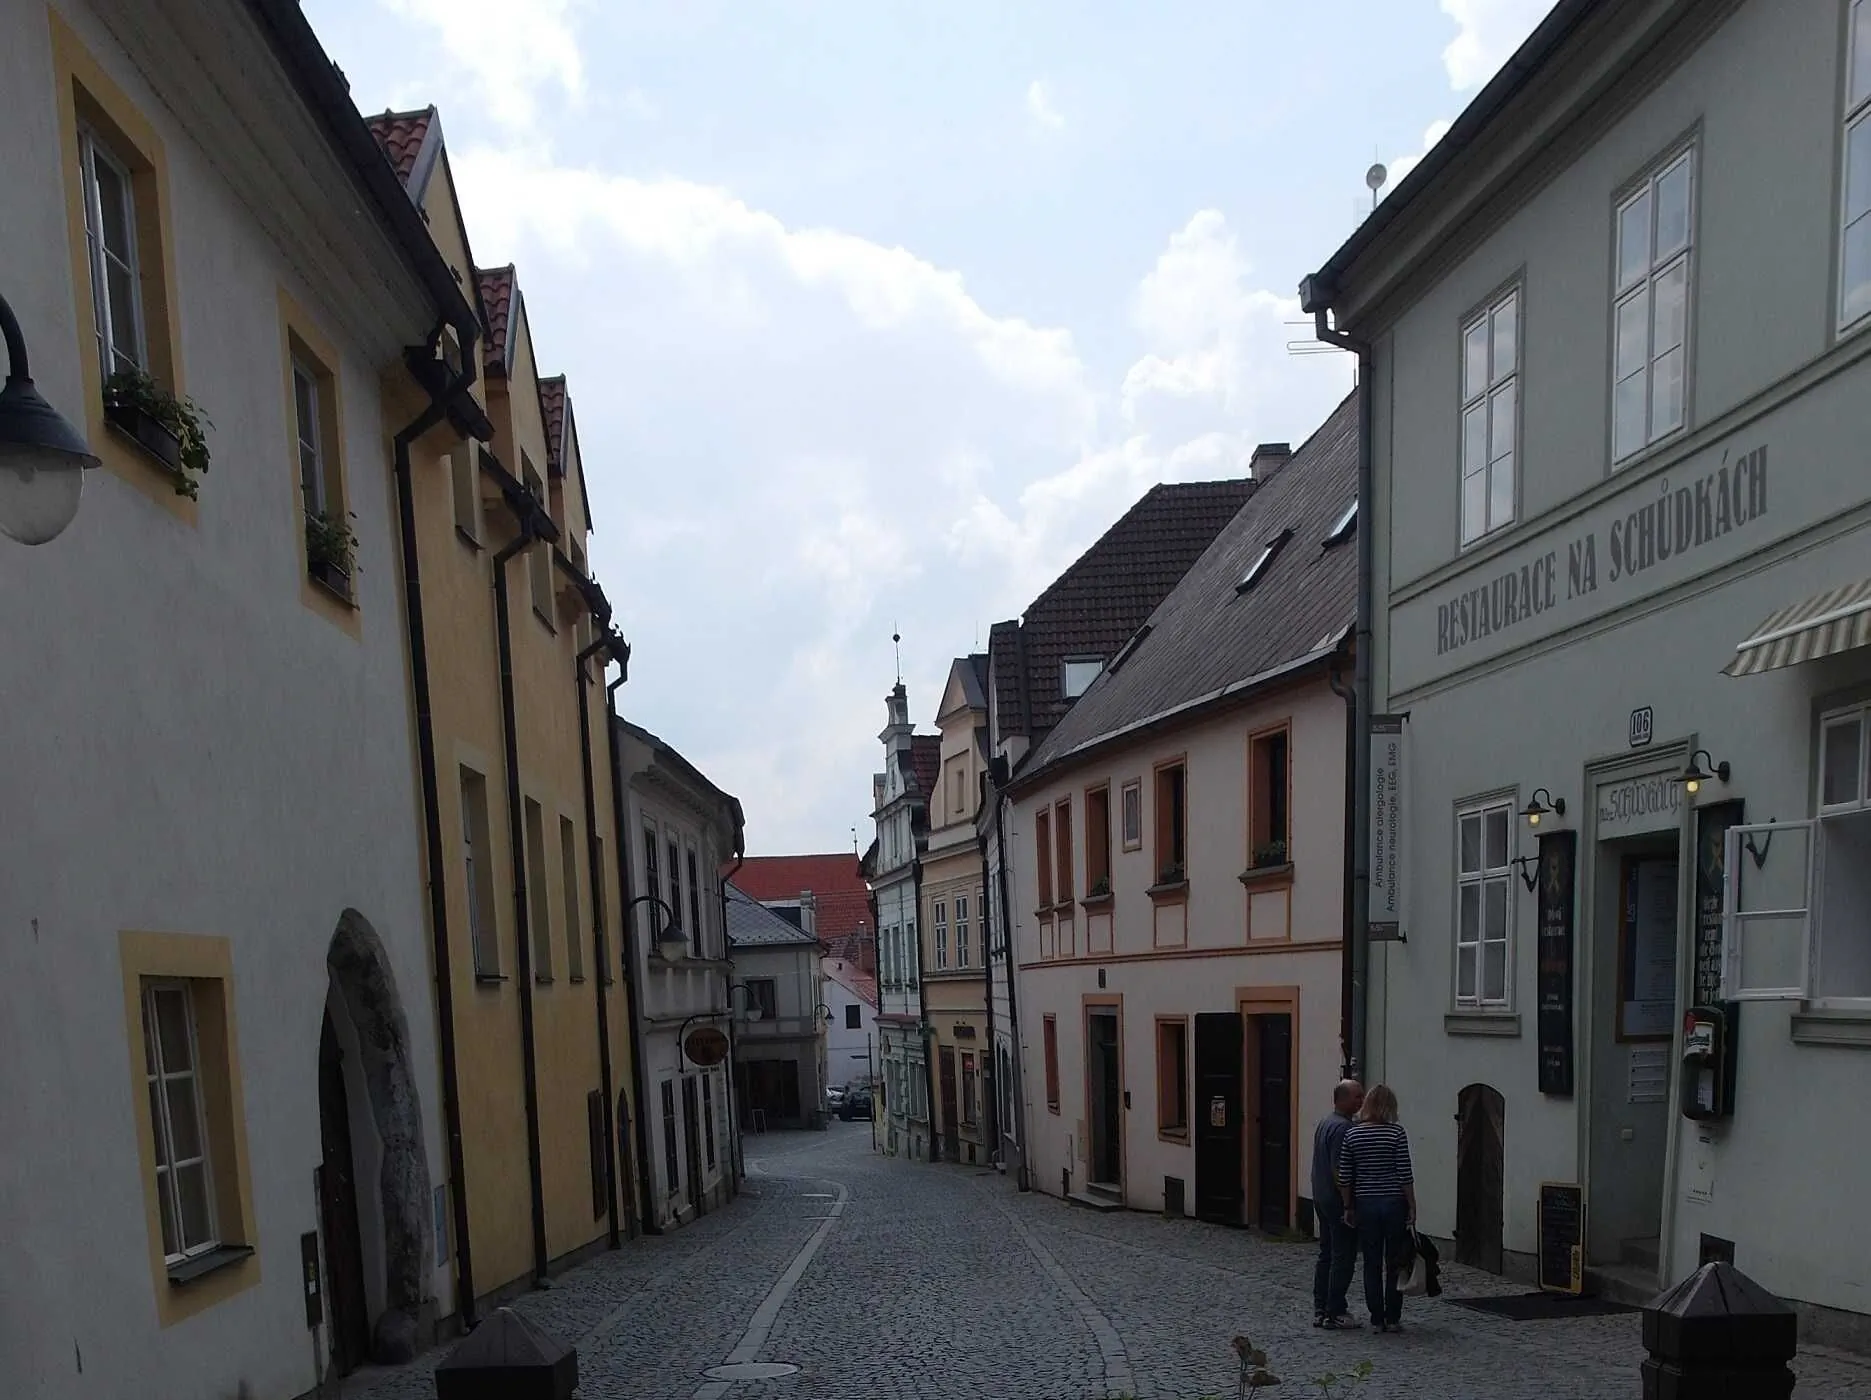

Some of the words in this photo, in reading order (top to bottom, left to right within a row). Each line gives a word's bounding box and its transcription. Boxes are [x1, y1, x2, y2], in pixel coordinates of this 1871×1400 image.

[1436, 551, 1557, 656] RESTAURACE
[1567, 533, 1598, 600] NA
[1609, 444, 1769, 583] SCHŮDKÁCH
[1632, 710, 1649, 736] 106
[1374, 767, 1386, 827] alergologie
[1374, 829, 1384, 889] Ambulance
[1386, 852, 1397, 913] Ambulance
